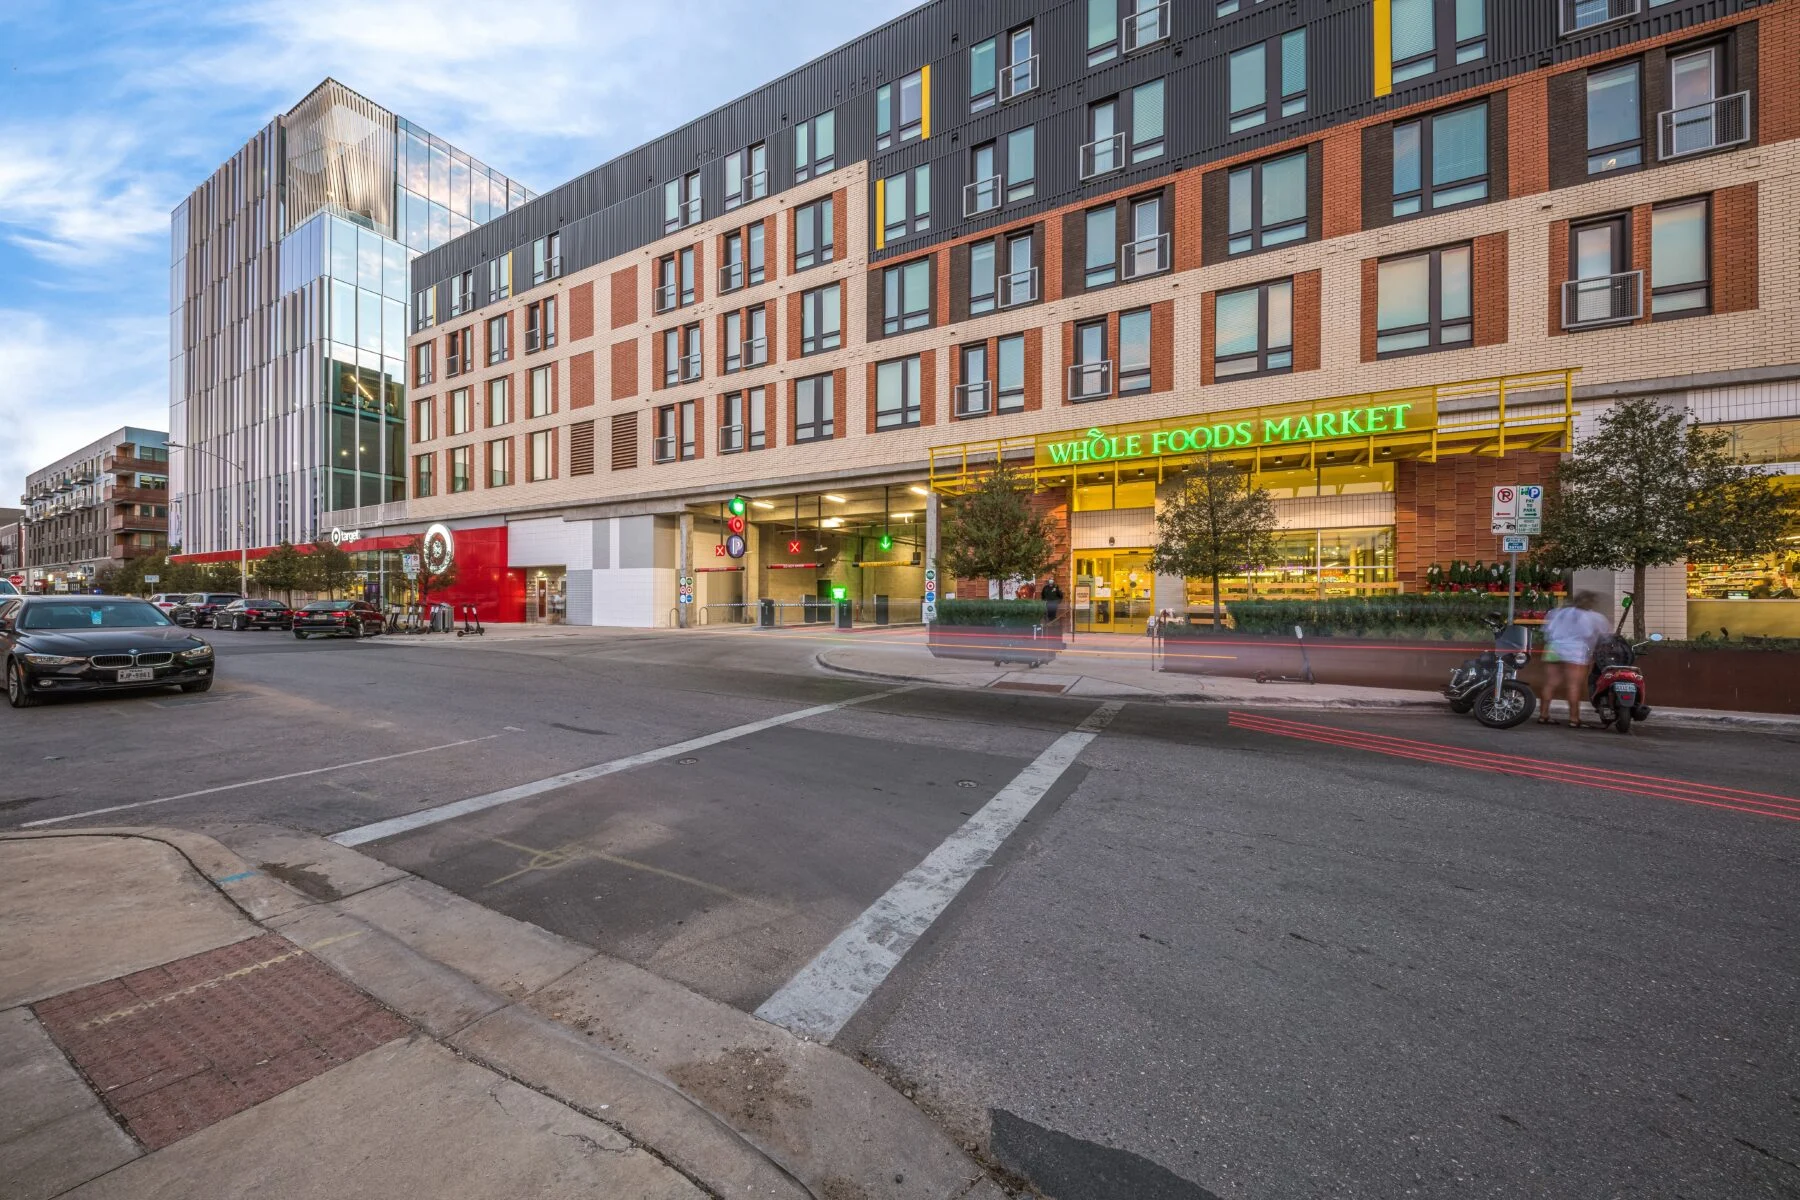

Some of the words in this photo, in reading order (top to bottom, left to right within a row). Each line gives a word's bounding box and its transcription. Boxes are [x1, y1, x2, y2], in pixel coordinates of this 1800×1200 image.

[1048, 427, 1142, 464] WHOLE
[1152, 421, 1252, 454] FOODS
[1263, 403, 1411, 442] MARKET
[341, 529, 360, 543] target
